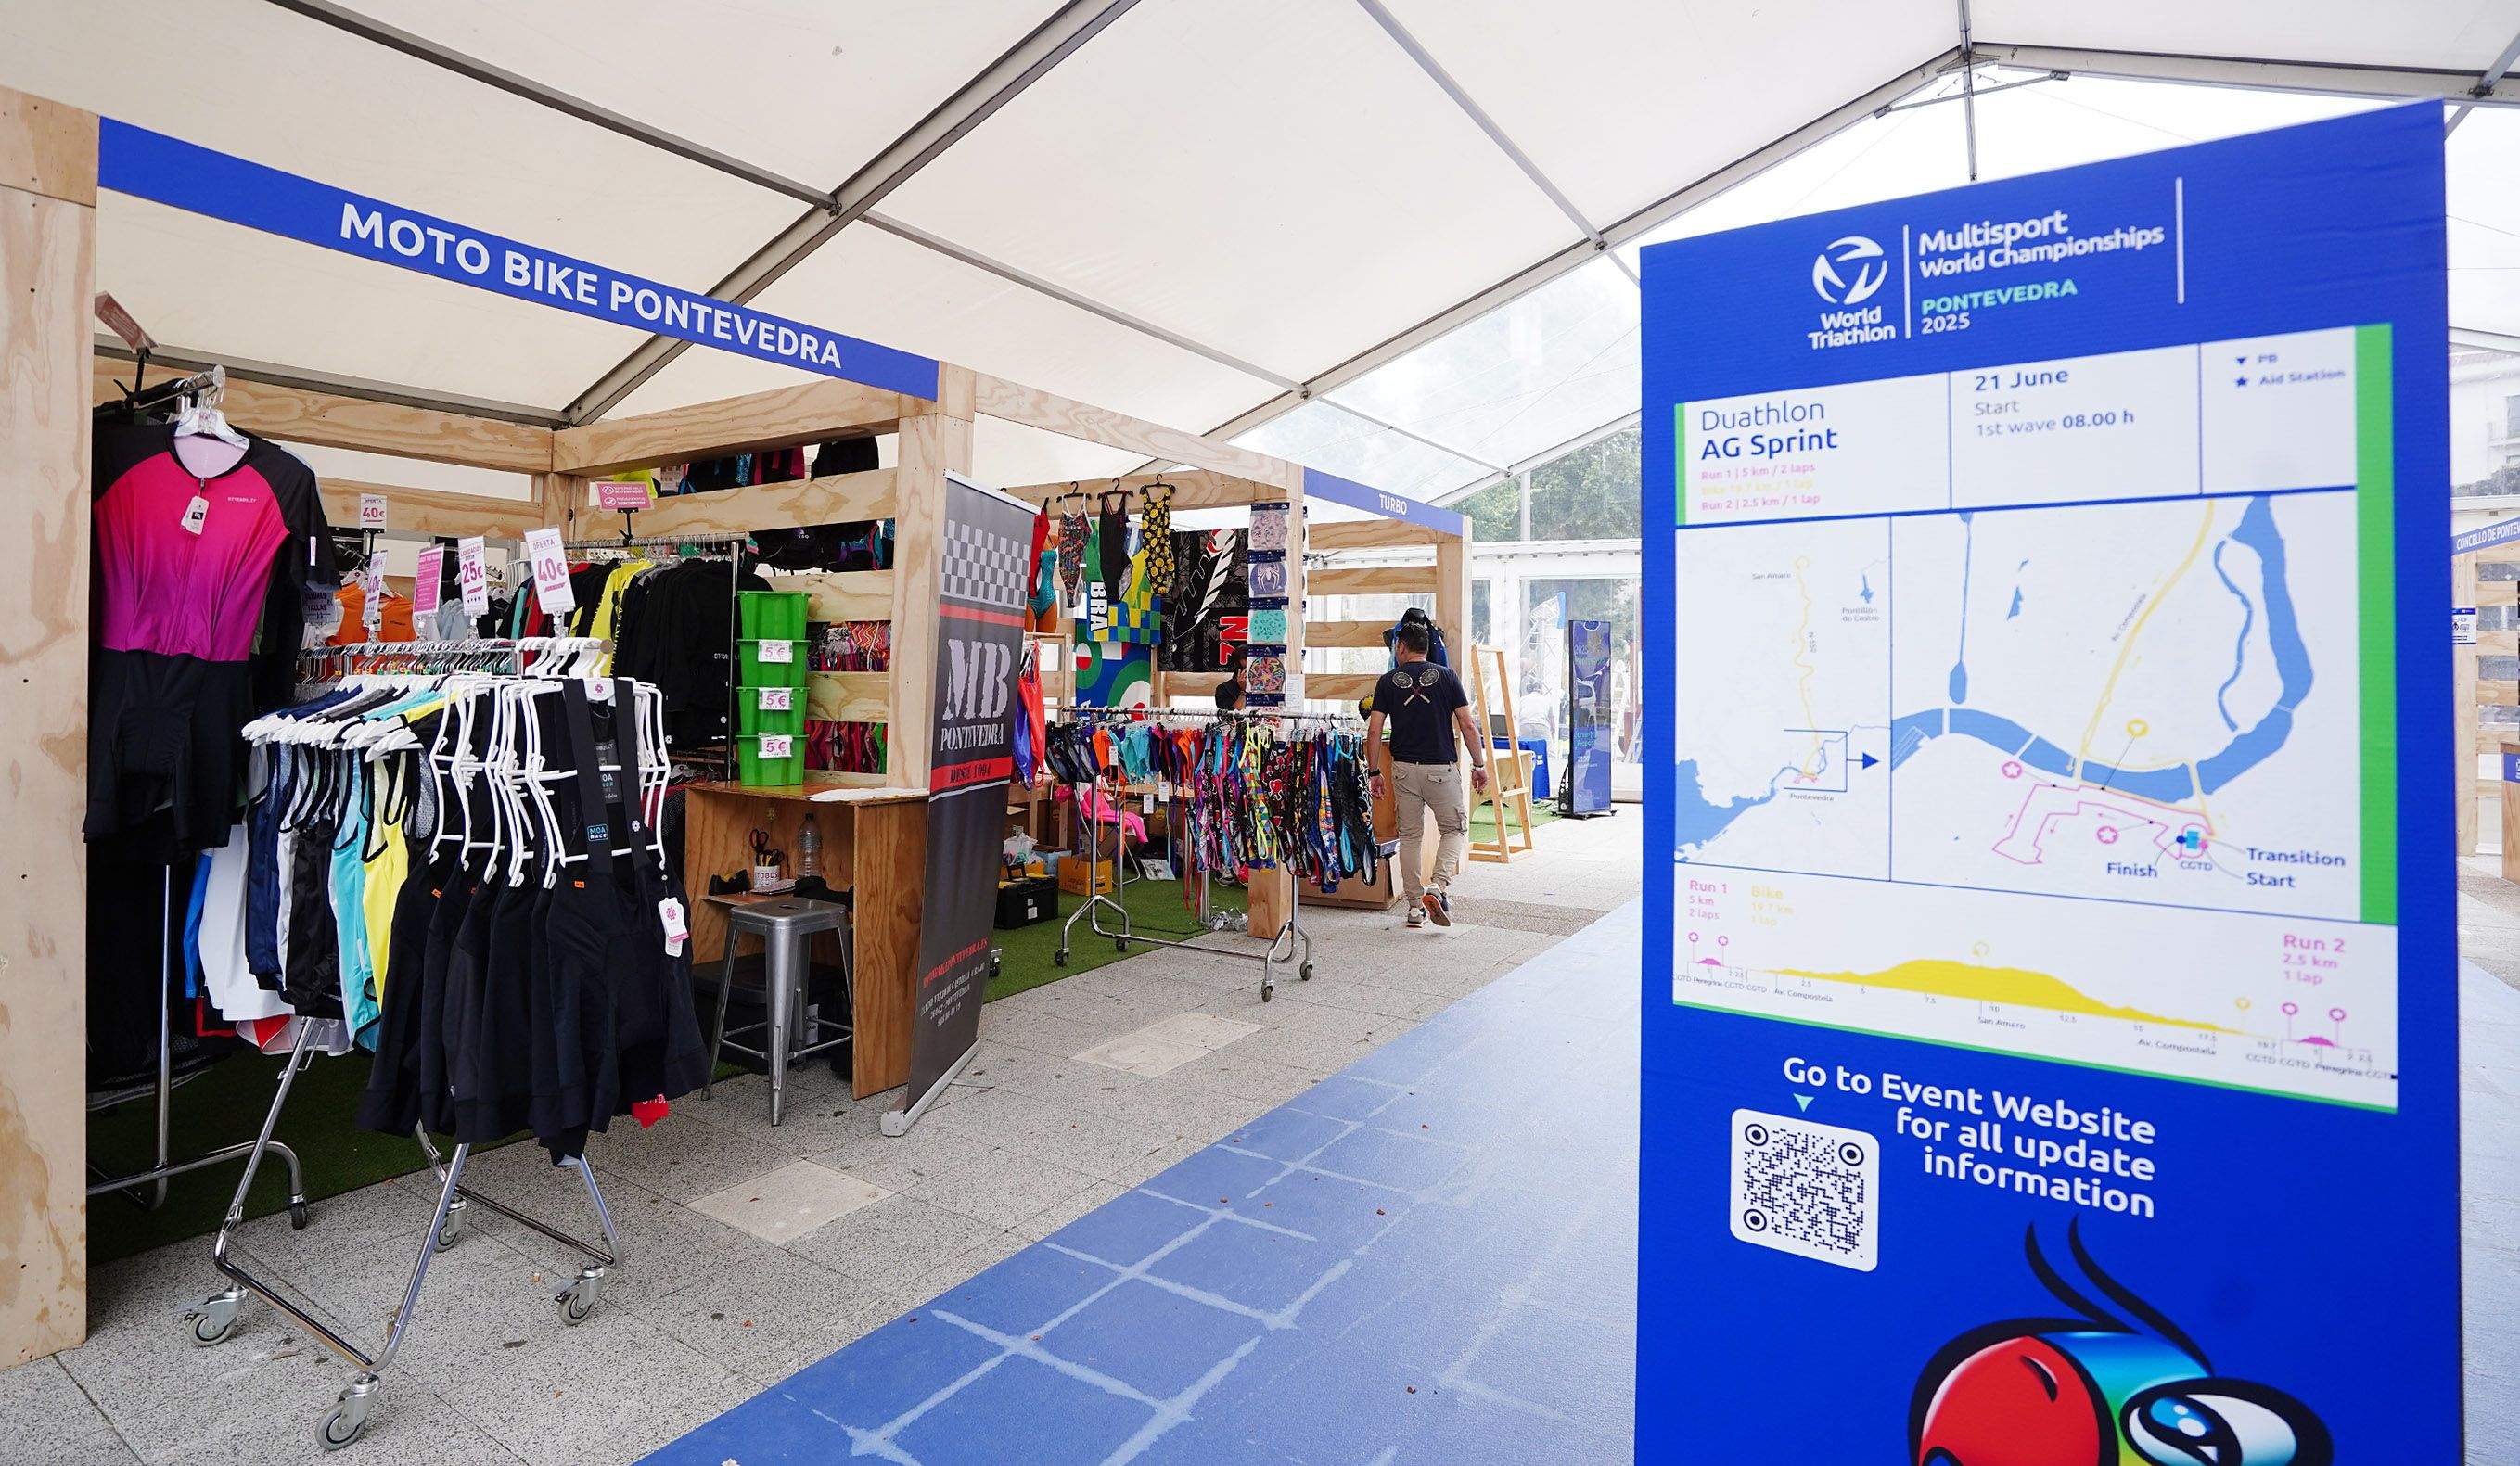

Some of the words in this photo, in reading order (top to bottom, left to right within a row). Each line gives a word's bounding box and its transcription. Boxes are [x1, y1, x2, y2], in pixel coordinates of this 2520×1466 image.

[1919, 210, 2069, 256] Multisport
[1920, 250, 1986, 279] World
[1989, 225, 2166, 269] Championships
[340, 202, 490, 274] MOTO
[505, 250, 598, 306] BIKE
[610, 280, 842, 369] PONTEVEDRA
[1922, 278, 2079, 316] PONTEVEDRA
[1820, 306, 1883, 331] World
[1921, 312, 1971, 335] 2025
[1808, 323, 1897, 351] Triathlon
[1975, 375, 2001, 391] 21
[2009, 369, 2070, 389] June
[2259, 374, 2284, 385] Aid
[2288, 369, 2347, 382] Station
[1702, 400, 1825, 432] Duathlon
[1975, 399, 2021, 416] Start
[1976, 421, 2004, 438] 1st
[2008, 417, 2057, 433] wave
[2062, 412, 2117, 429] 08.00
[2122, 409, 2135, 424] h
[1701, 437, 1741, 460] AG
[1750, 427, 1838, 459] Sprint
[1701, 471, 1723, 480] Run
[1743, 467, 1749, 478] 5
[1752, 466, 1770, 476] km
[1781, 465, 1788, 474] 2
[1791, 463, 1817, 475] laps
[1379, 493, 1407, 516] TURBO
[1701, 502, 1723, 511] Run
[1725, 500, 1733, 509] 2
[1743, 498, 1759, 508] 2.5
[1761, 497, 1780, 506] km
[1800, 493, 1822, 504] lap
[363, 507, 385, 518] 40€
[532, 539, 556, 551] OFERTA
[2456, 530, 2487, 551] CONCELLO
[2488, 528, 2497, 542] DE
[462, 560, 482, 584] 25€
[538, 557, 566, 581] 40€
[1090, 581, 1109, 632] BRA
[942, 638, 1012, 720] MB
[940, 723, 1004, 752] PONTEVEDRA
[1790, 793, 1835, 802] Pontevedra
[589, 826, 606, 835] MOA
[2180, 860, 2214, 872] CGTD
[2247, 848, 2347, 867] Transition
[2107, 862, 2158, 879] Finish
[1690, 879, 1716, 892] Run
[2247, 872, 2296, 888] Start
[1689, 895, 1695, 904] 5
[1698, 896, 1715, 907] km
[1751, 885, 1784, 899] Bike
[1689, 909, 1695, 918] 2
[1697, 909, 1721, 921] laps
[2284, 934, 2326, 951] Run
[2334, 938, 2346, 952] 2
[2283, 953, 2308, 966] 2.5
[2312, 956, 2338, 970] km
[1673, 973, 1692, 983] GTD
[1724, 981, 1745, 990] CGTD
[2296, 970, 2323, 986] lap
[1746, 984, 1768, 994] CGTD
[1787, 989, 1834, 1003] Compostela
[1995, 1020, 2027, 1029] Amaro
[2365, 1069, 2389, 1080] CGT
[1783, 1057, 1826, 1087] Go
[1836, 1065, 1872, 1095] to
[1882, 1073, 1984, 1115] Event
[1992, 1090, 2156, 1145] Website
[1896, 1107, 1950, 1142] for
[1958, 1120, 2004, 1154] all
[2014, 1137, 2156, 1181] update
[1924, 1146, 2155, 1219] information
